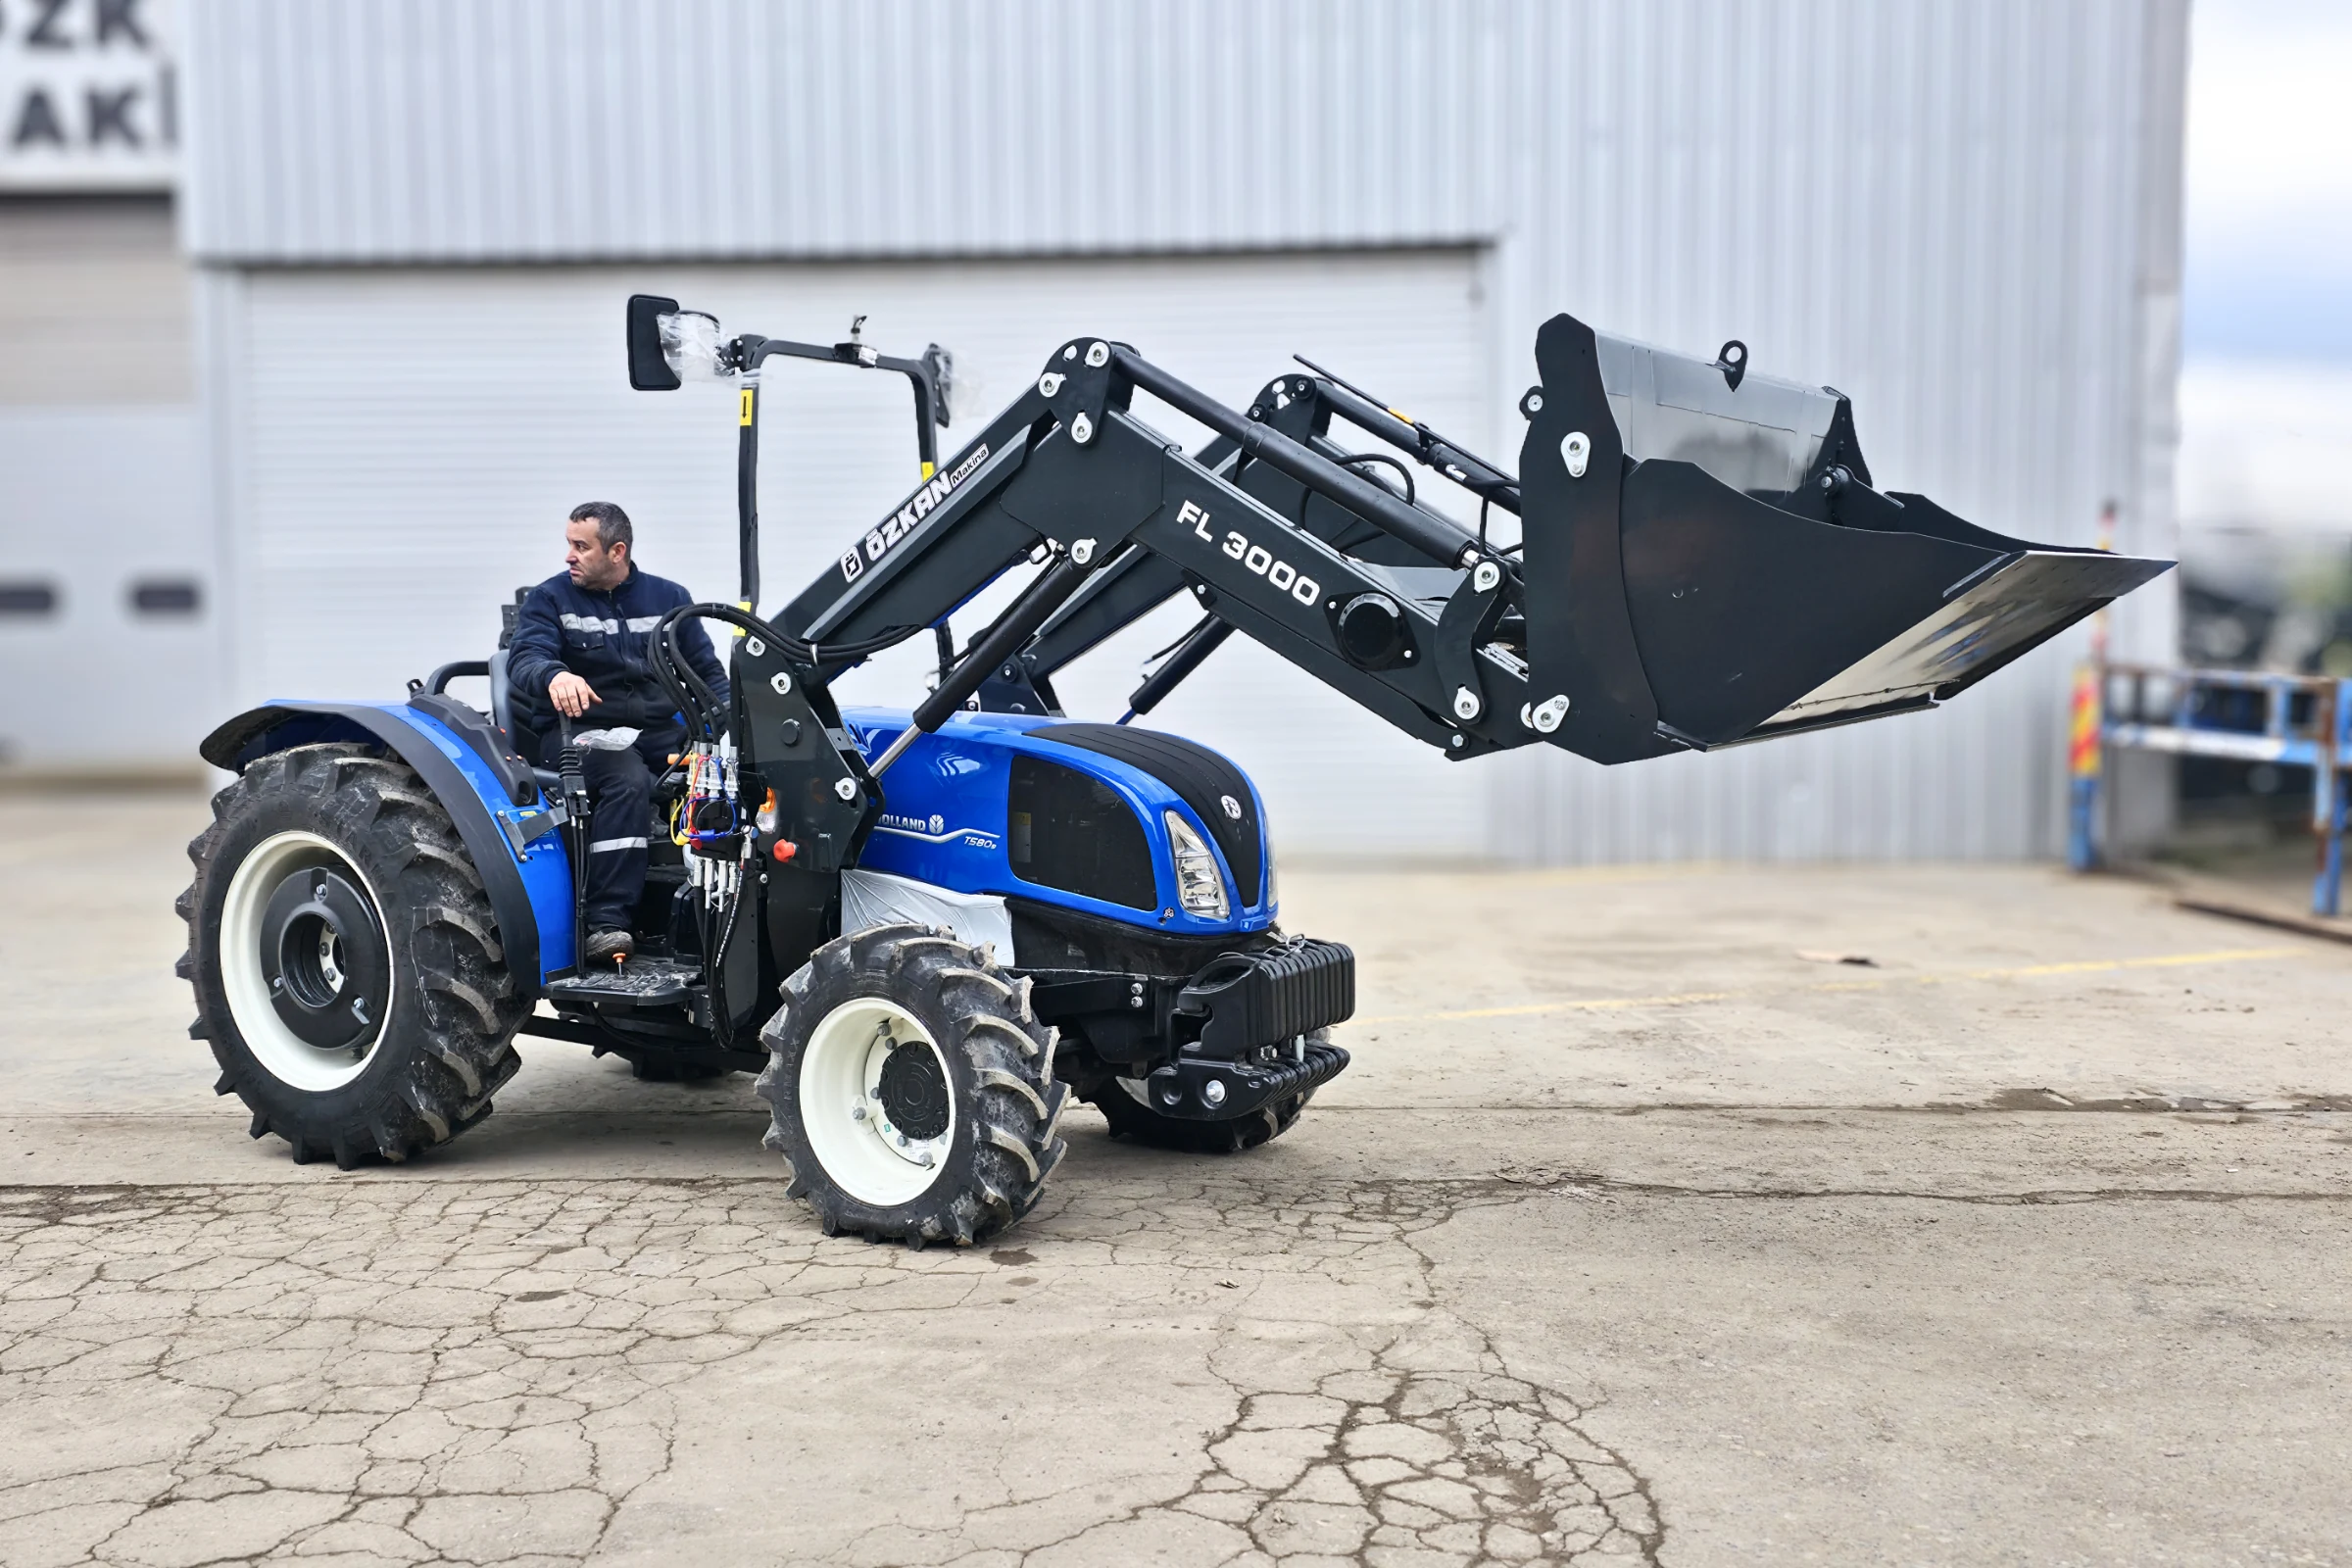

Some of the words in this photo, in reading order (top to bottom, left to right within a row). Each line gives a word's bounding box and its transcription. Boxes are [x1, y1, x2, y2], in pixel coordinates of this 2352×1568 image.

[0, 0, 153, 52] ZK
[865, 470, 953, 562] ÖZKAN
[951, 448, 988, 484] Makina
[1176, 499, 1213, 543] FL
[1222, 530, 1321, 607] 3000
